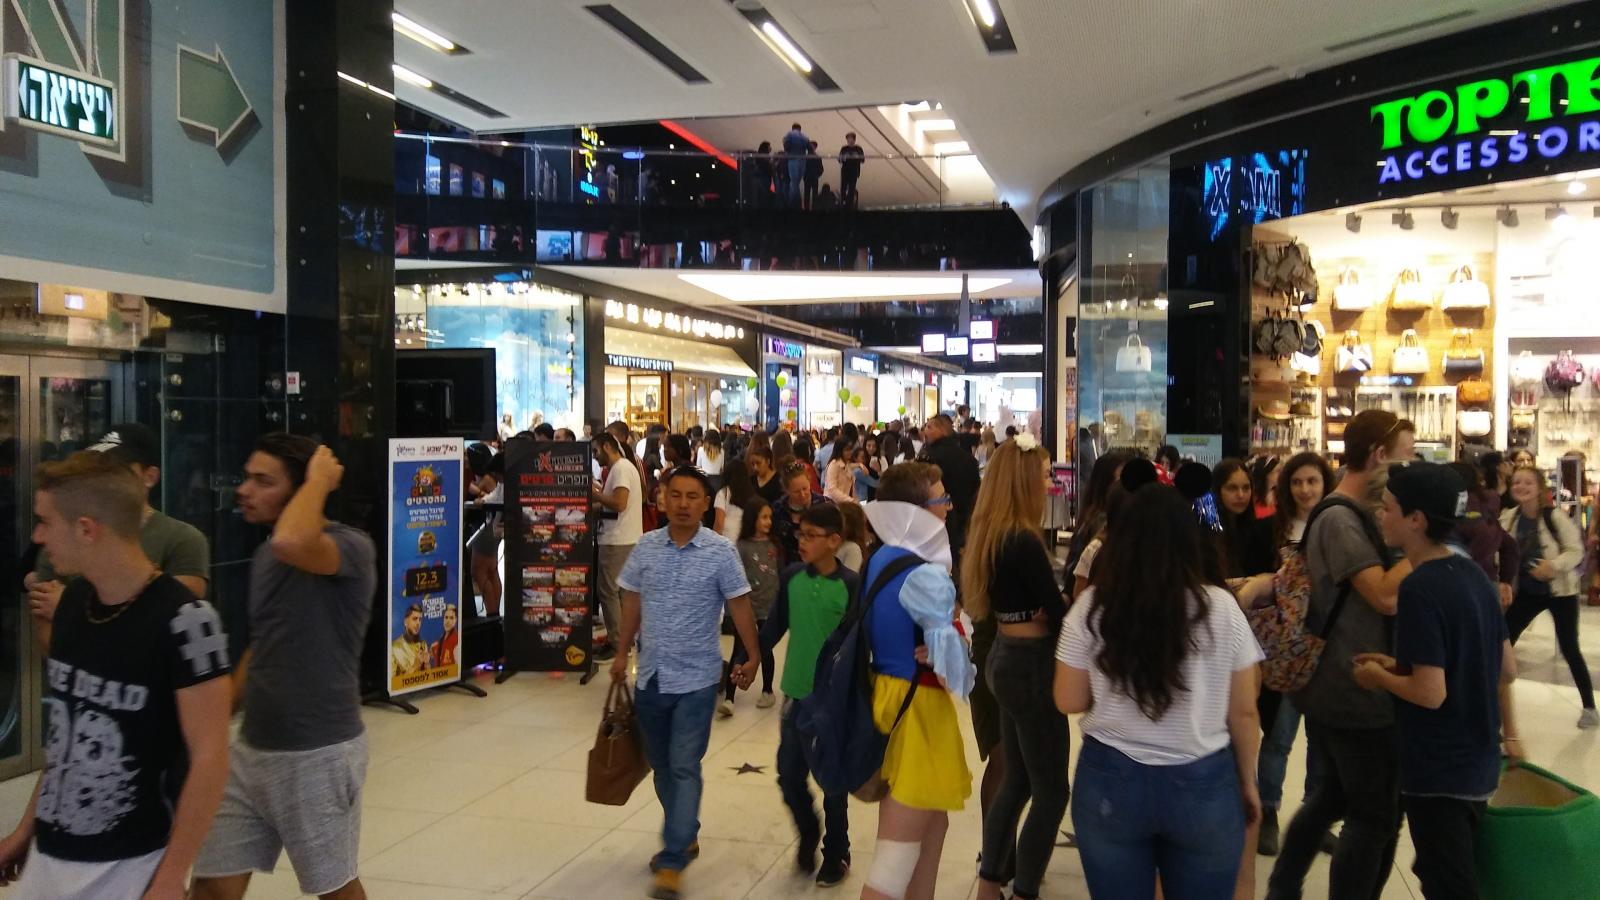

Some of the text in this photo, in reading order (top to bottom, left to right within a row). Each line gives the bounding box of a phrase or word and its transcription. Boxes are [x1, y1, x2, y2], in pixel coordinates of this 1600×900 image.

[29, 67, 105, 135] יציאה
[1379, 121, 1600, 184] ACCESSOR
[557, 474, 588, 485] תפריט
[416, 571, 438, 586] 12.3
[72, 669, 149, 712] DEAD
